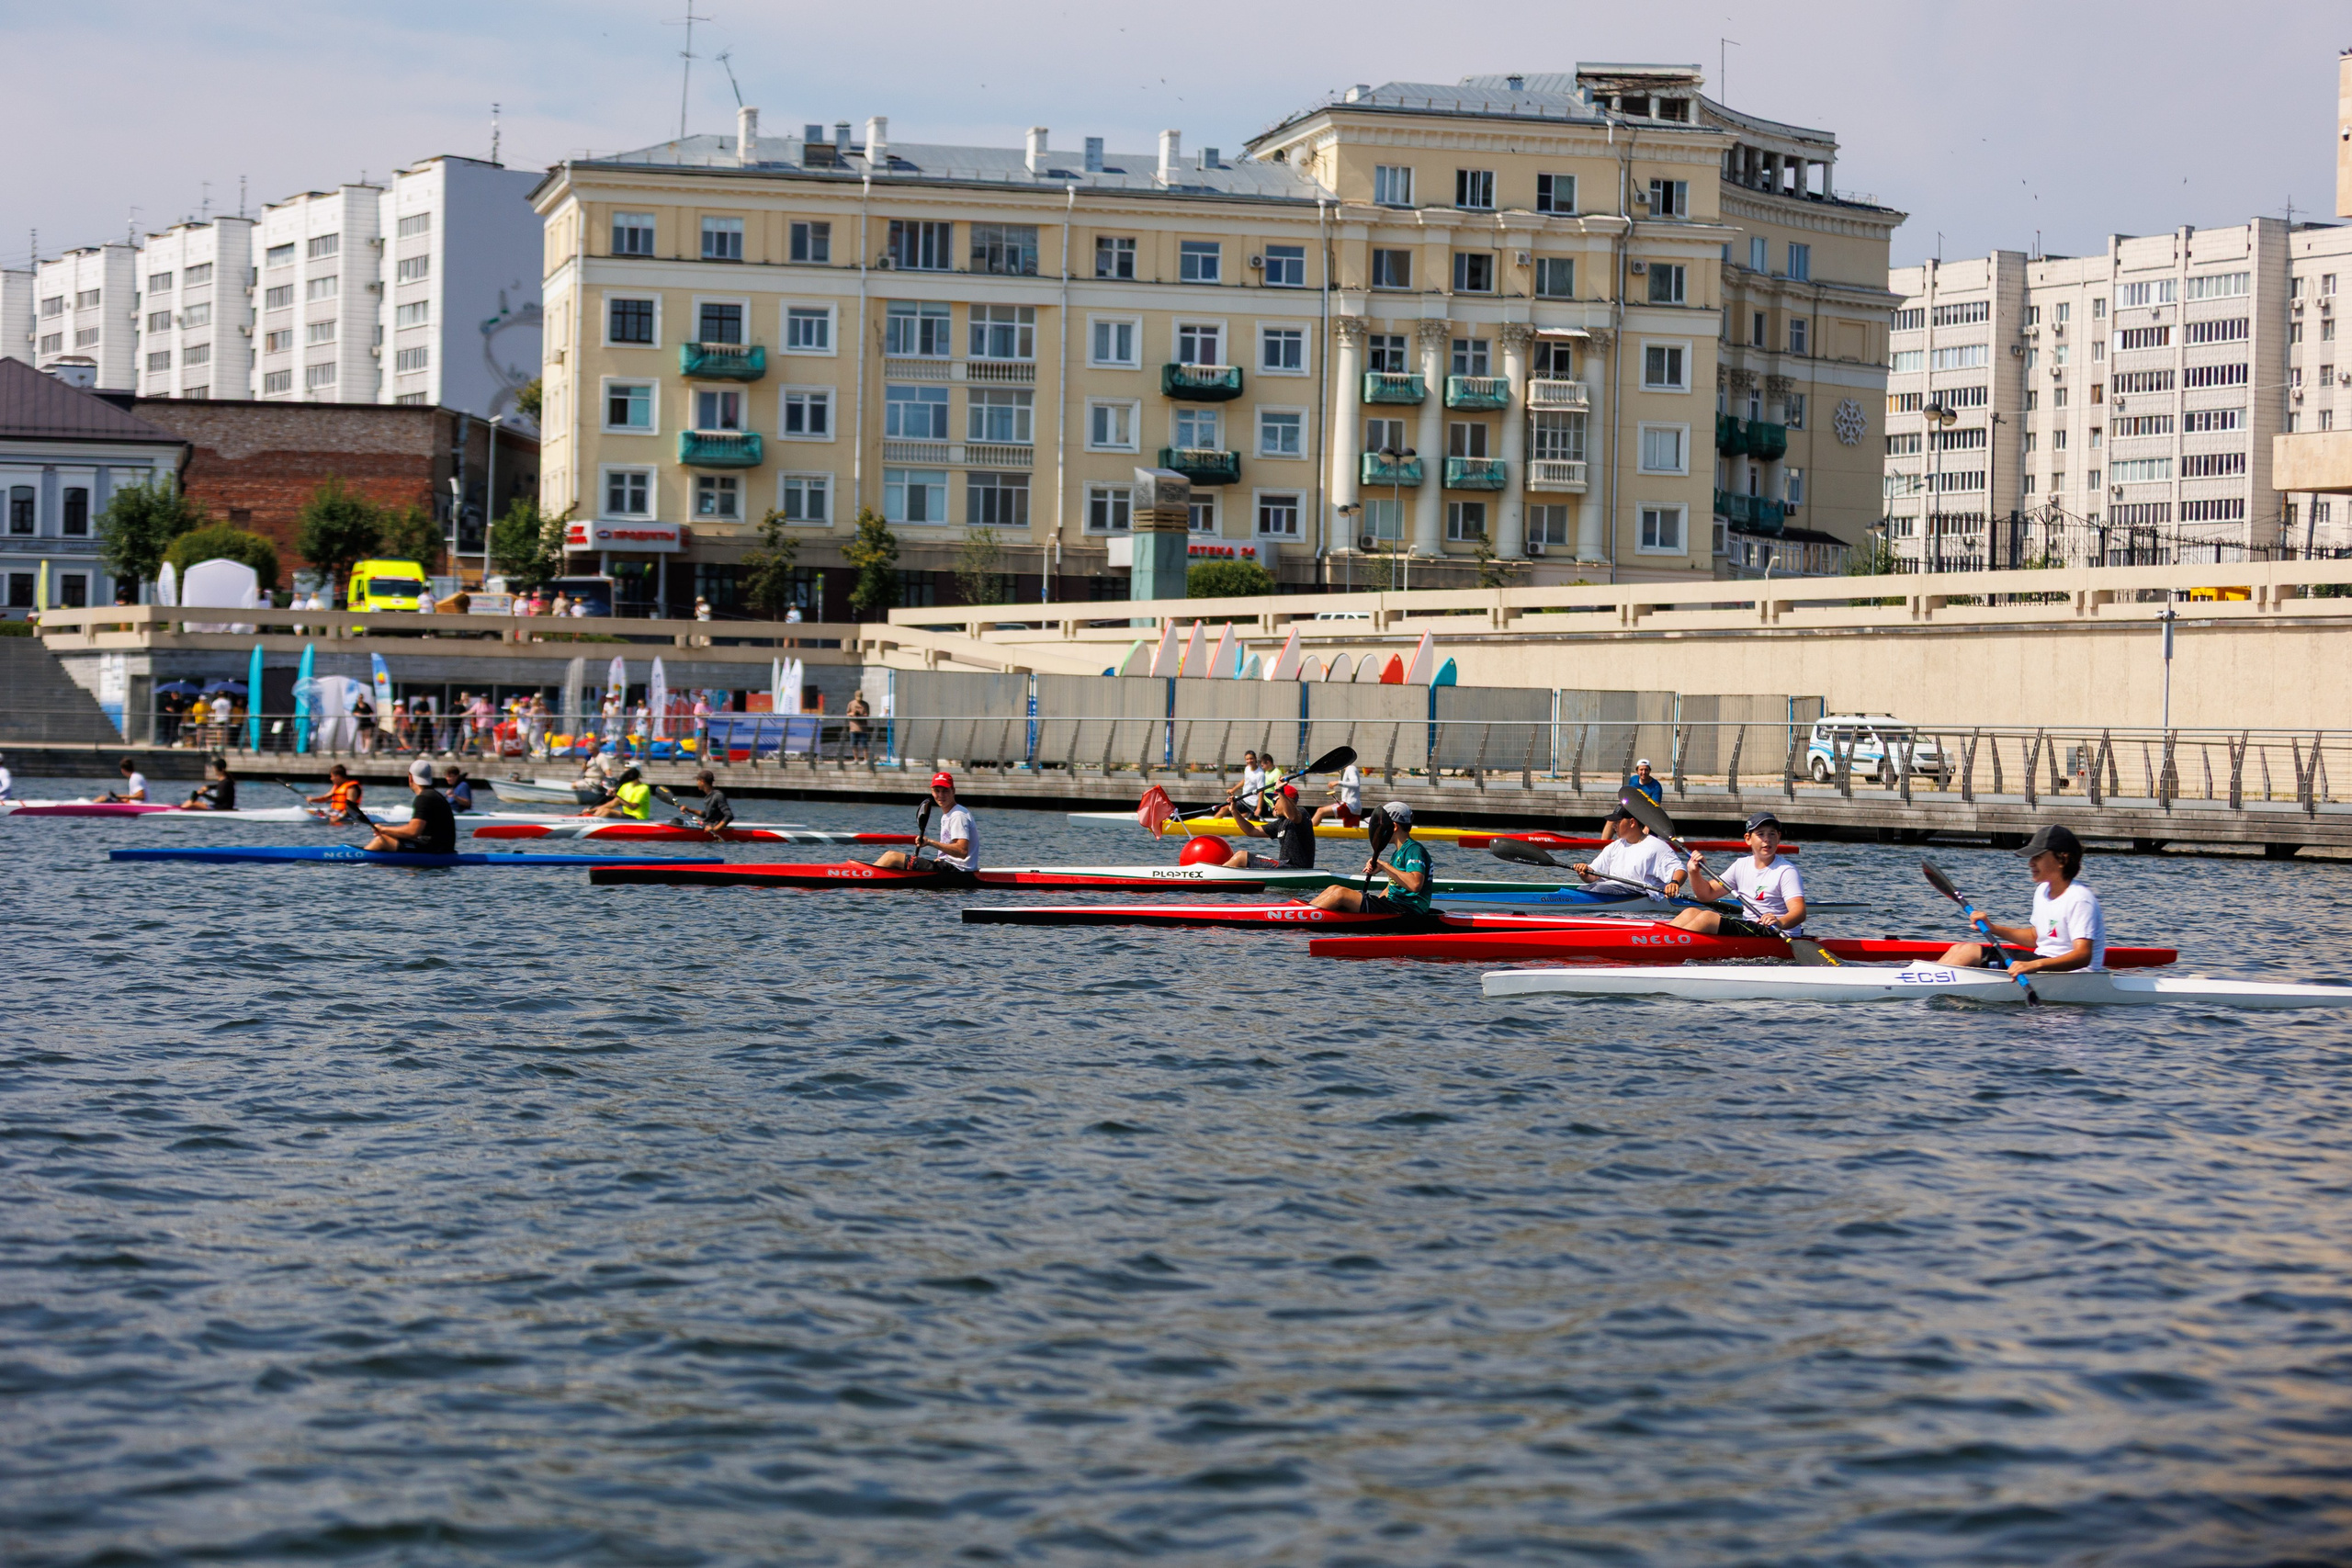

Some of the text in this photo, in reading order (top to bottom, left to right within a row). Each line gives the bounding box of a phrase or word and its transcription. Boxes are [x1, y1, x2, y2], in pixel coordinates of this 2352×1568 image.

[1188, 545, 1256, 557] ПТЕКА 24
[827, 869, 873, 877] NELO
[1267, 910, 1323, 920] NELO
[1631, 934, 1691, 945] NELO
[1894, 970, 1957, 983] ECSI
